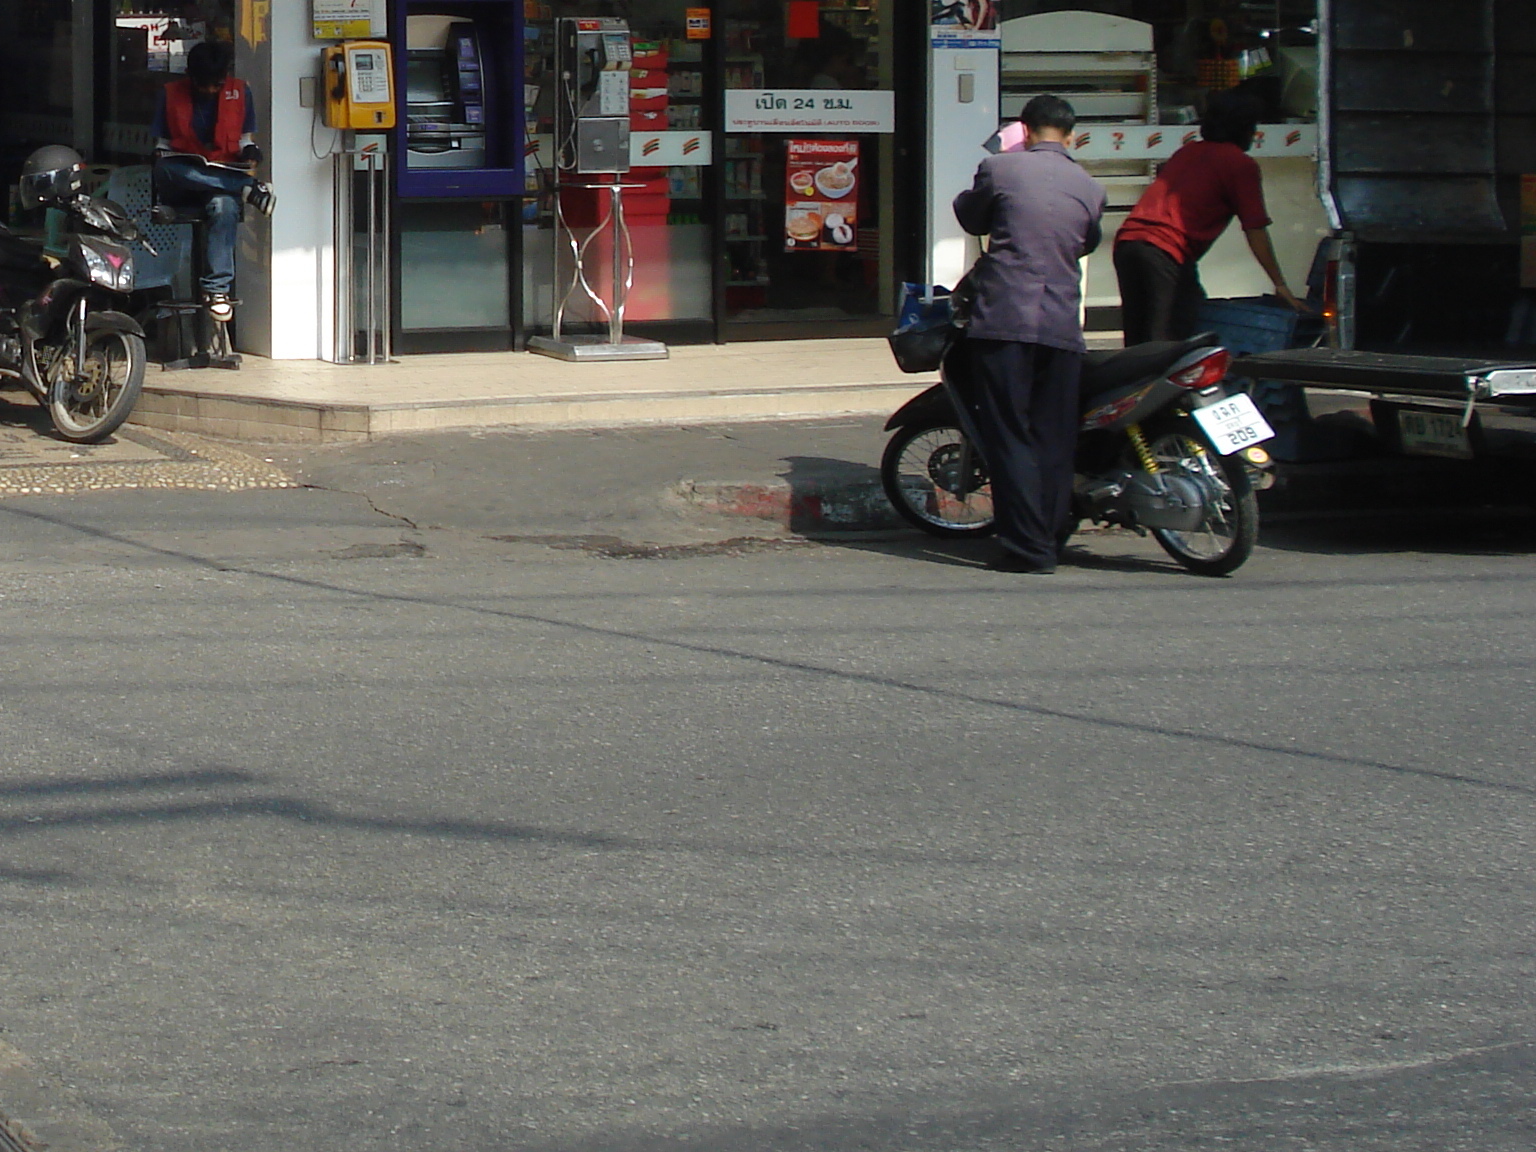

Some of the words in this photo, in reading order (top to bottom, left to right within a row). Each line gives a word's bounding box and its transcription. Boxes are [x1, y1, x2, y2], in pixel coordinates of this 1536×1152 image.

[755, 93, 787, 110] เปิด
[794, 98, 815, 110] 24
[1227, 426, 1258, 445] 209
